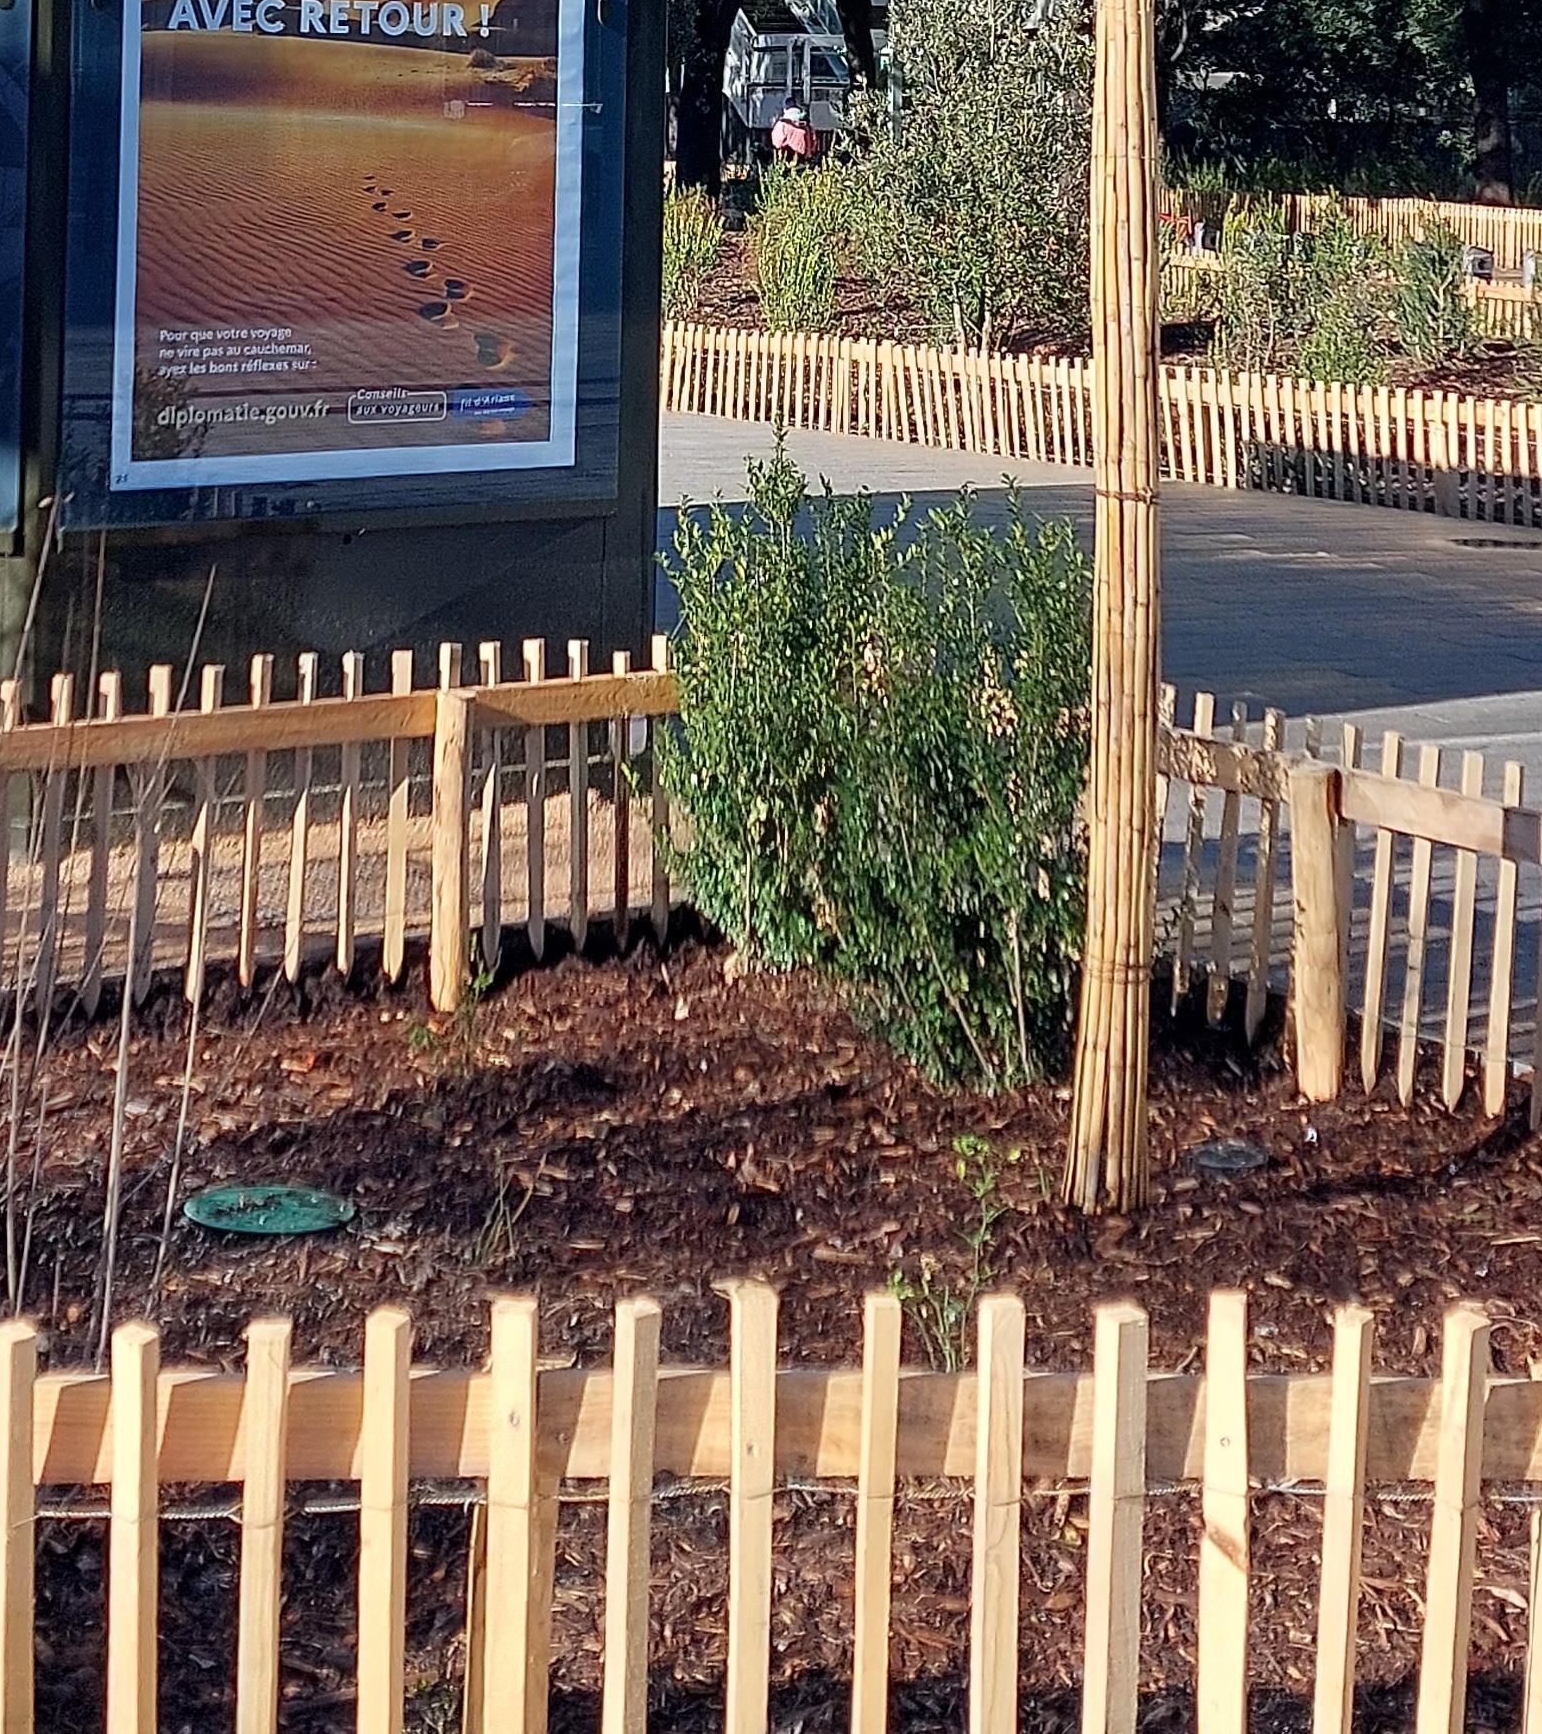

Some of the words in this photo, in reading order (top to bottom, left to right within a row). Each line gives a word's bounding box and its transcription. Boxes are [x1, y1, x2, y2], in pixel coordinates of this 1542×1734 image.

[159, 329, 187, 342] Pour
[190, 330, 214, 344] que
[216, 329, 248, 340] votre
[250, 328, 292, 341] voyage
[159, 348, 175, 358] ne
[177, 345, 201, 358] vire
[203, 346, 224, 359] pas
[226, 345, 241, 356] au
[243, 342, 312, 356] cauchemar,
[158, 364, 187, 379] ayez
[189, 361, 206, 374] les
[209, 360, 239, 373] bons
[241, 359, 289, 372] réflexes
[357, 387, 408, 400] Conseils
[157, 399, 331, 430] diplomatie.gouv.fr
[357, 404, 376, 415] aux
[381, 402, 440, 417] voyageurs
